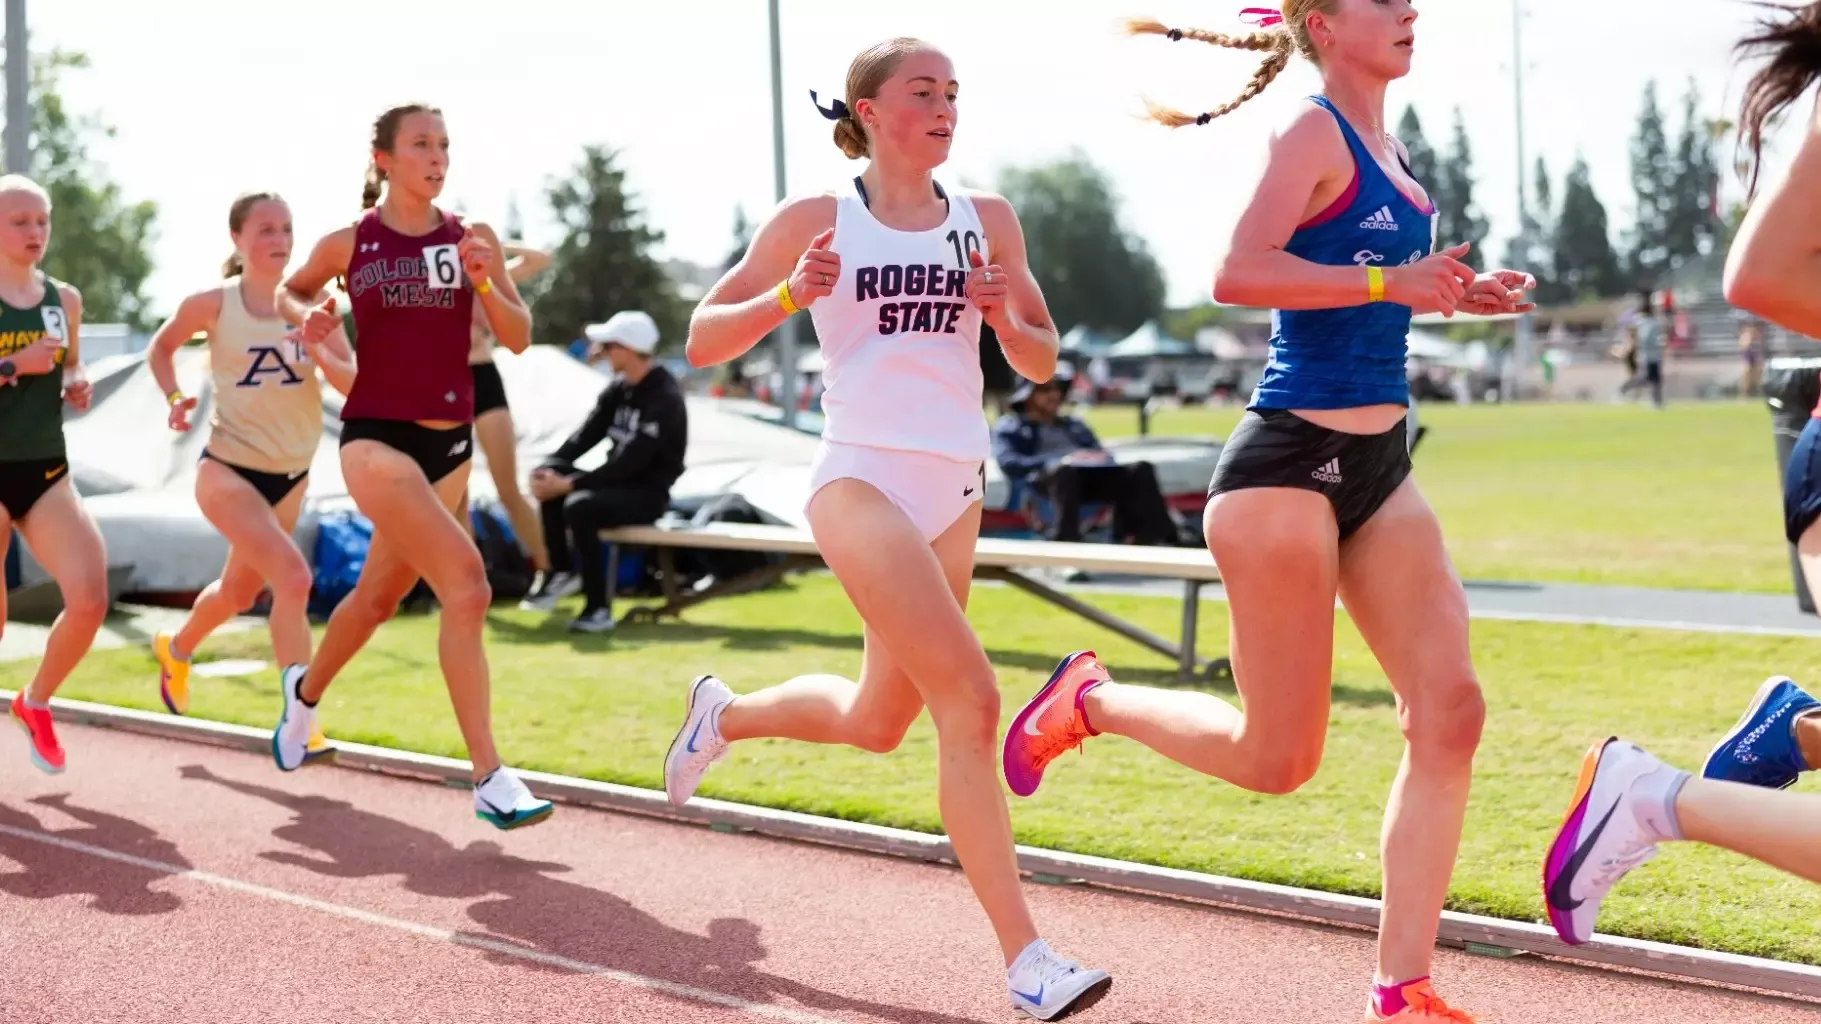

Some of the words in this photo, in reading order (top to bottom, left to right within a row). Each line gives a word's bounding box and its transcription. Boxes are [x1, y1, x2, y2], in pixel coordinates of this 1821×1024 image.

[1359, 219, 1399, 232] adidas
[434, 248, 455, 285] 6
[946, 230, 986, 269] 10
[350, 256, 475, 298] COLOR
[856, 264, 970, 302] ROGER
[381, 281, 455, 310] MESA
[878, 302, 966, 335] STATE
[0, 330, 48, 349] WAY
[235, 346, 304, 387] A
[1310, 470, 1343, 484] adidas
